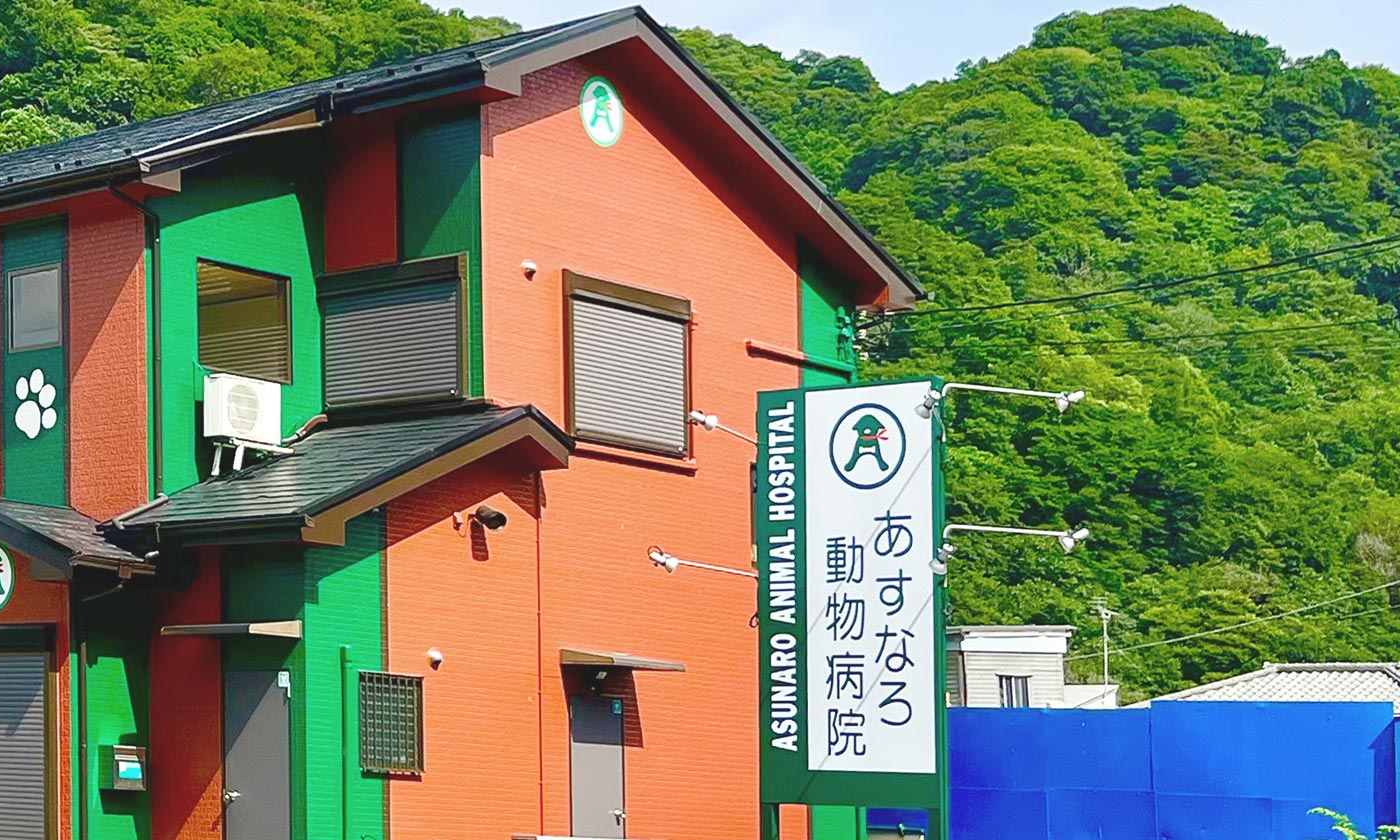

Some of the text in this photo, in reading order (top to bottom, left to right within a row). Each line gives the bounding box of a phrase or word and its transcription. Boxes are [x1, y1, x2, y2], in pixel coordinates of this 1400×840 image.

[769, 401, 798, 752] ASUNARO ANIMAL HOSPITAL
[825, 535, 866, 757] 動物病院
[873, 509, 915, 727] あすなろ
